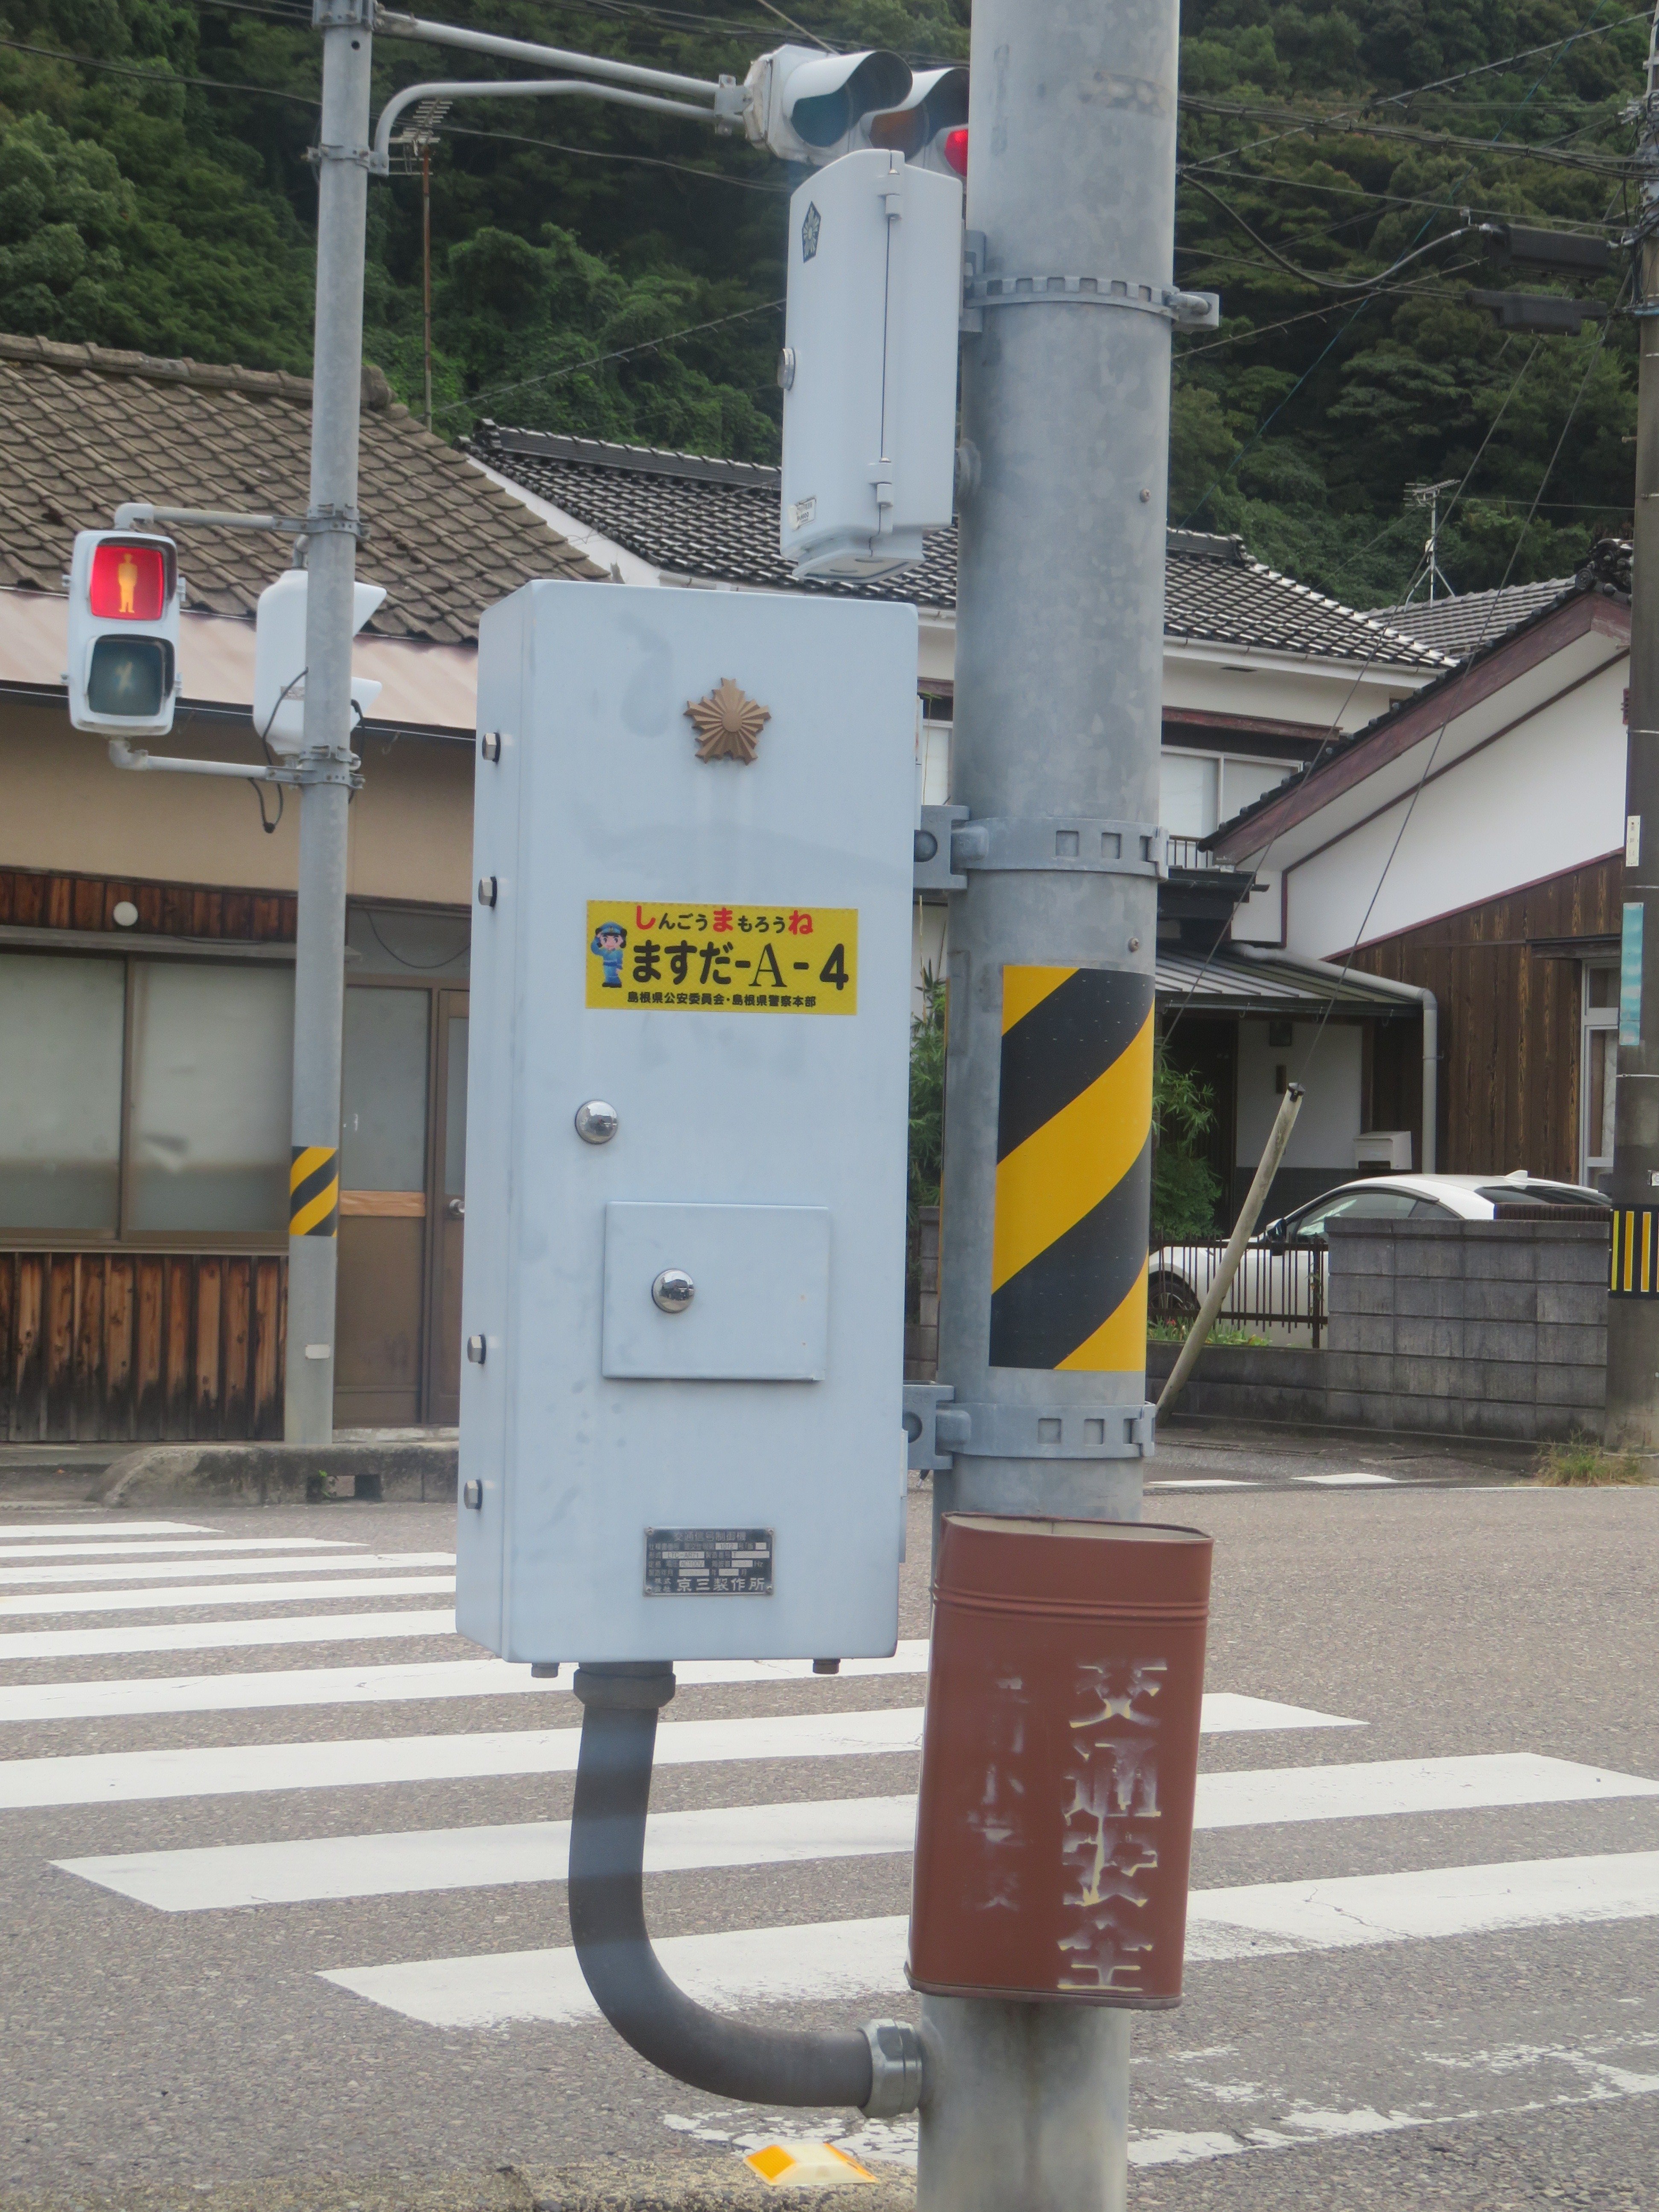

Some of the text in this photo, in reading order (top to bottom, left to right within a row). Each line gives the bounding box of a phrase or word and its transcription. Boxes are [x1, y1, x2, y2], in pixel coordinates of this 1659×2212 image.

[636, 905, 813, 935] しんごうまもろうね
[627, 991, 816, 1008] 島根県公安委員会・島根県警察本部
[677, 1578, 765, 1592] 京三製作所
